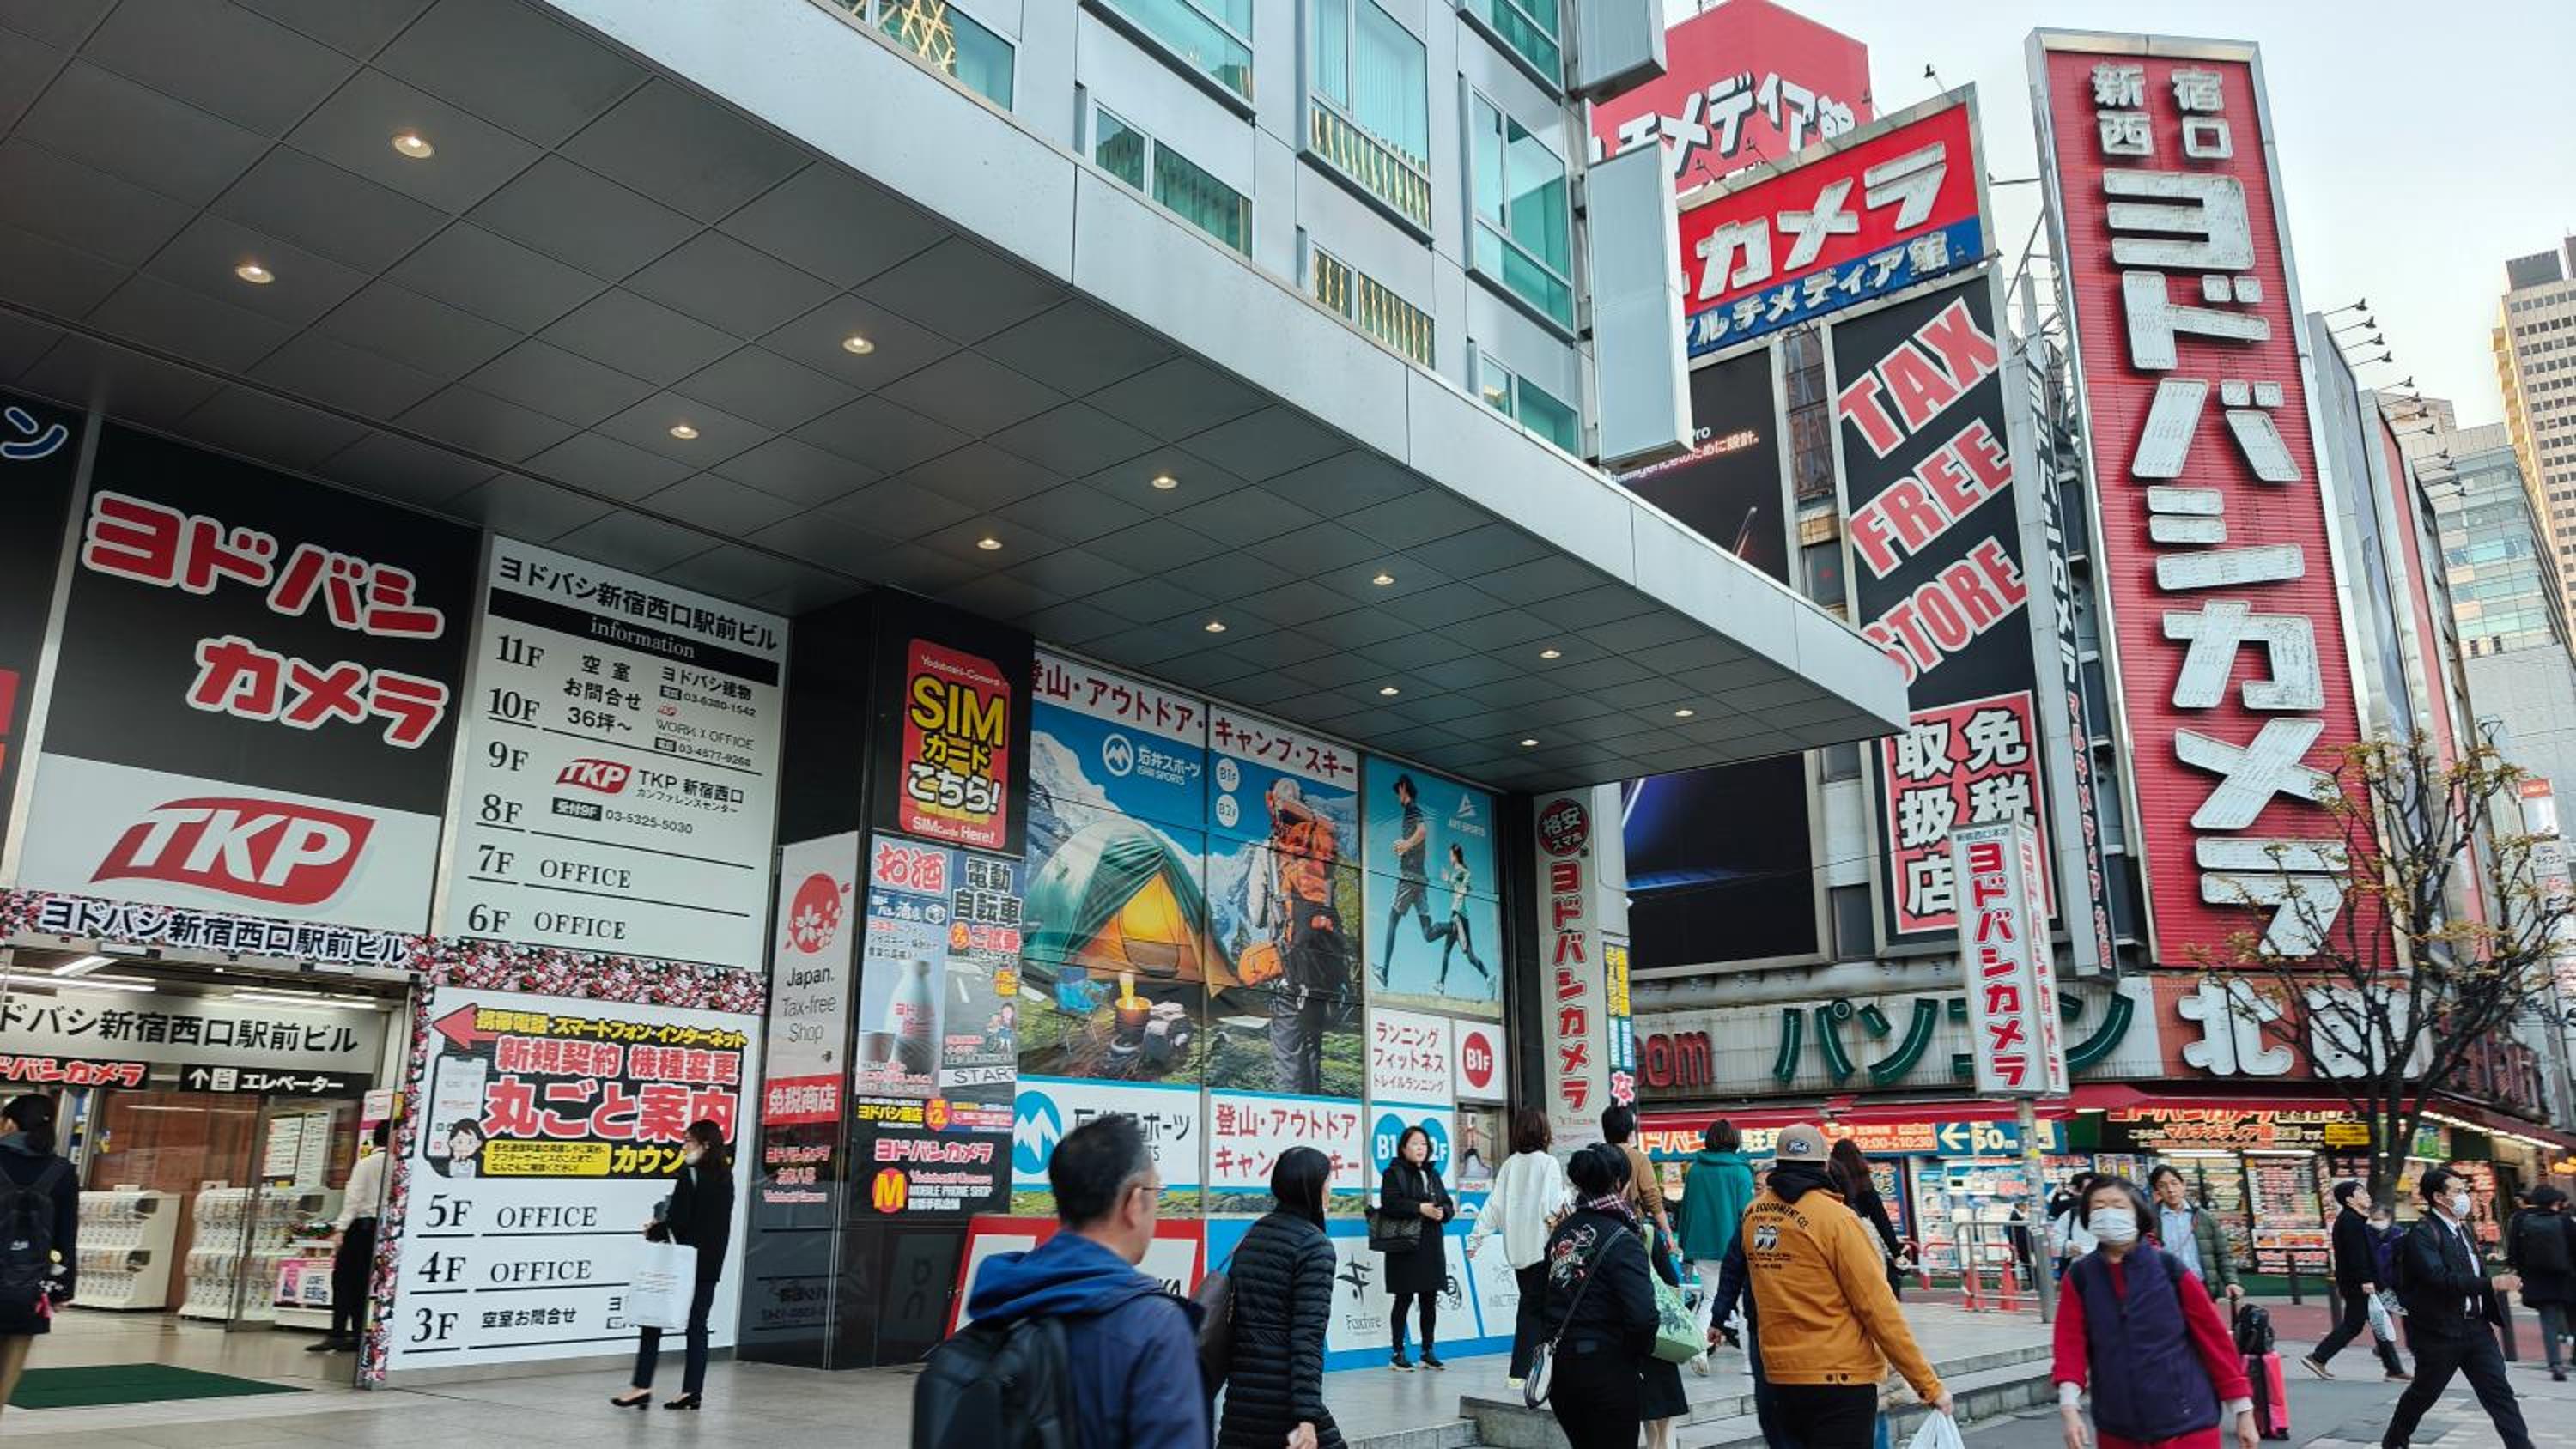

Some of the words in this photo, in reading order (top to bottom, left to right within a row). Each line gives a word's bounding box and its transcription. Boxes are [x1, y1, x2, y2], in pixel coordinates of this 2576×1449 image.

[2091, 64, 2225, 112] 新宿
[2097, 110, 2233, 159] 西口
[1682, 142, 1947, 301] カメラ
[1686, 232, 1949, 346] ルチメディア館
[1838, 295, 1998, 459] TAX
[1848, 417, 2013, 579] FREE
[83, 490, 445, 639] ヨドバシ
[2103, 169, 2353, 956] ヨドバシカメラ
[499, 556, 777, 651] ヨドバシ新宿西口駅前ビル
[1860, 536, 2027, 688] STORE
[495, 634, 545, 669] 11F
[591, 615, 695, 658] information
[186, 635, 450, 749] カメラ
[488, 688, 540, 722] 10F
[563, 677, 641, 711] お問合せ
[910, 674, 1005, 747] SIM
[489, 741, 529, 772] 9F
[925, 735, 992, 772] カード
[1215, 718, 1354, 778] キャンプ・スキー
[562, 761, 625, 794] TKP
[639, 770, 677, 790] TKP
[683, 779, 744, 803] 新宿西口
[1962, 708, 2036, 827] 免税
[481, 794, 524, 824] 8F
[1544, 807, 1580, 837] 格安
[1894, 722, 1957, 919] 取扱店
[129, 809, 352, 886] TKP
[478, 845, 514, 874] 7F
[540, 859, 631, 888] OFFICE
[876, 841, 945, 892] お酒
[967, 857, 1014, 894] 電動
[468, 904, 510, 932] 6F
[535, 912, 626, 939] OFFICE
[954, 888, 1023, 925] 自転車
[39, 899, 410, 965] ヨドバシ新宿西口駅前ビル
[1966, 840, 2027, 1088] ヨドバシカメラ
[1550, 860, 1592, 1113] ヨドバシカメラ
[782, 996, 837, 1018] Tax-free
[788, 1024, 824, 1045] Shop
[1376, 1022, 1438, 1048] ランニング
[1773, 991, 2134, 1087] パソン
[495, 1034, 622, 1076] 新規契約
[628, 1044, 742, 1084] 機種変更
[1374, 1047, 1445, 1073] フィットネス
[1466, 1048, 1491, 1072] B1F
[240, 1074, 344, 1093] エレベーター
[1374, 1075, 1445, 1093] トレイルランニング
[482, 1076, 739, 1144] 丸ごと案内
[1216, 1103, 1357, 1141] 登山・アウトドア
[874, 1138, 994, 1164] ヨドバシカメラ
[1215, 1145, 1359, 1179] キャンキー
[426, 1193, 472, 1228] 5F
[496, 1206, 598, 1228] OFFICE
[873, 1173, 906, 1210] M
[418, 1251, 466, 1283] 4F
[490, 1260, 592, 1283] OFFICE
[411, 1307, 459, 1343] 3F
[481, 1307, 577, 1330] 空室お問合せ
